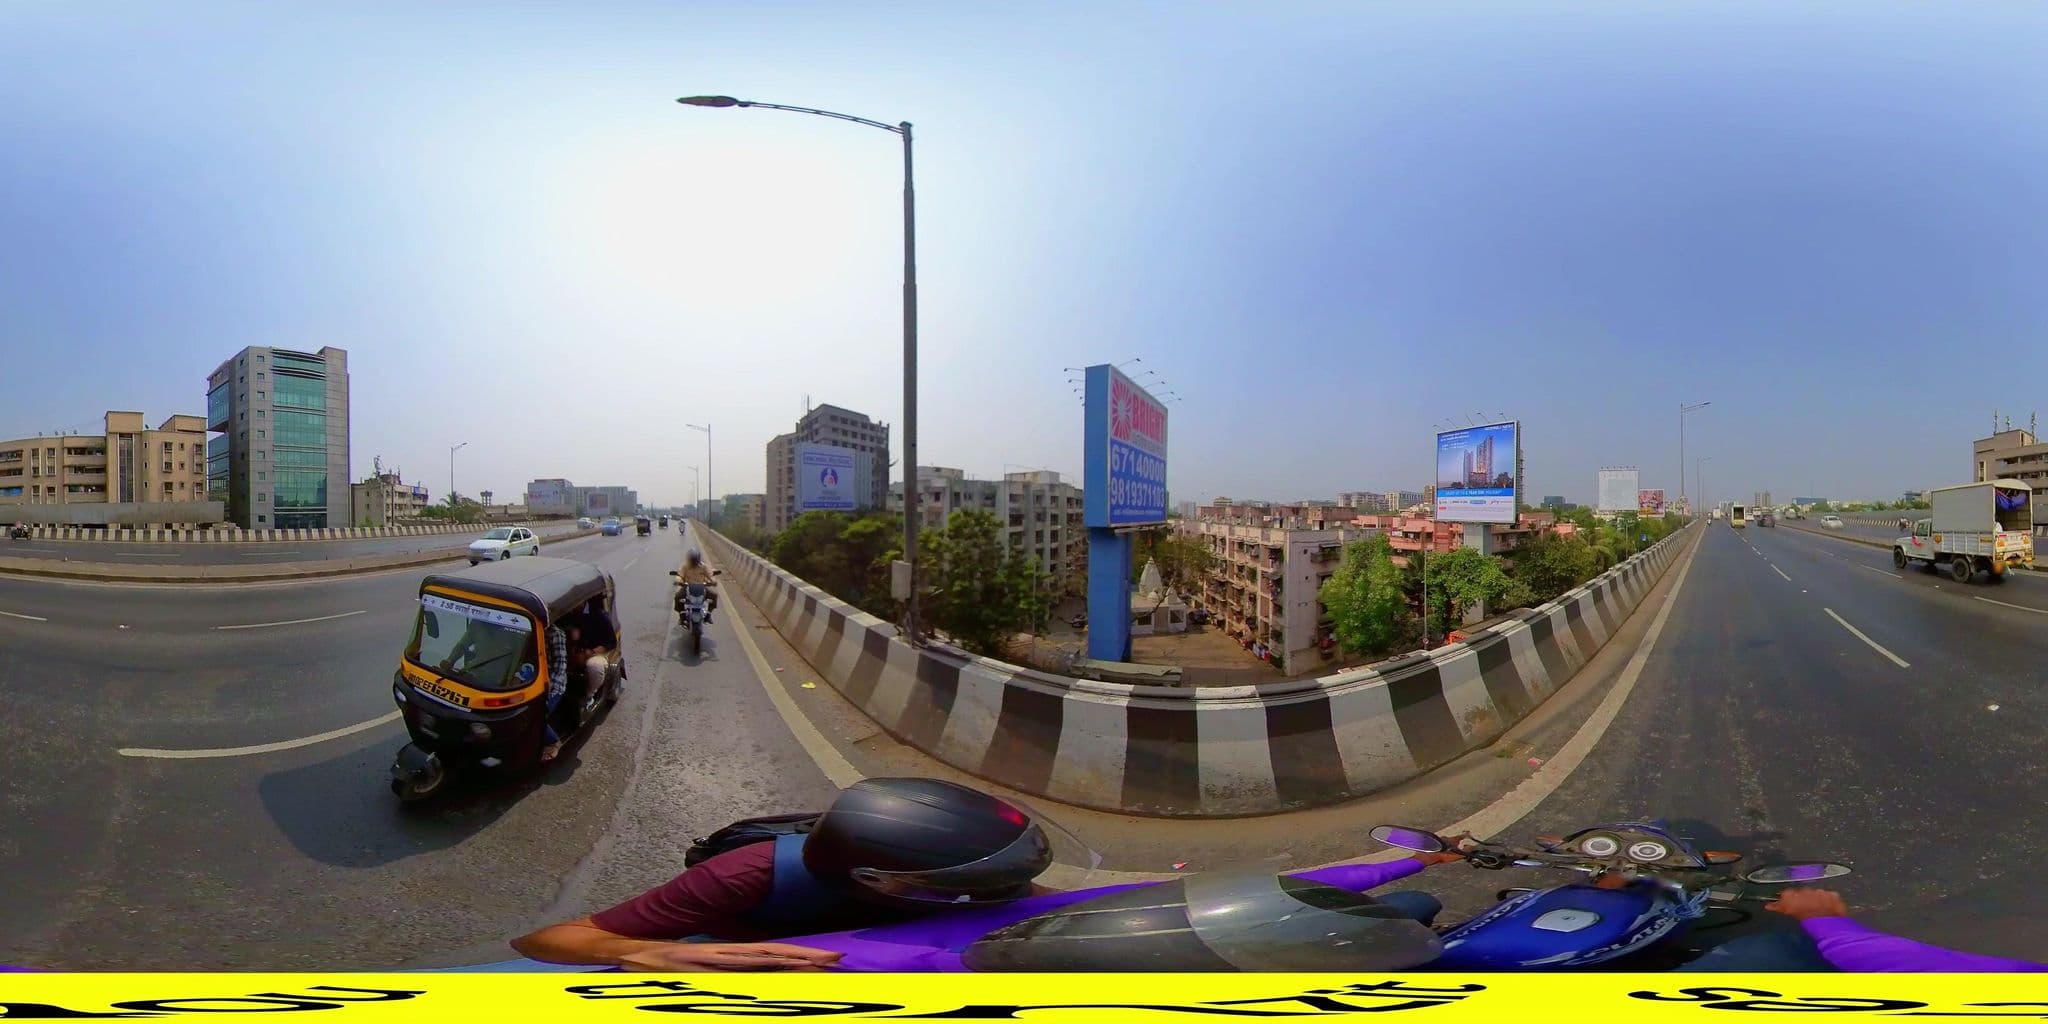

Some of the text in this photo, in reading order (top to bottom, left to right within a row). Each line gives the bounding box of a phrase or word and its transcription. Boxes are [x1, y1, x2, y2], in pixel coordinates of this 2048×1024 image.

[1132, 394, 1165, 445] BRIGHT
[1111, 444, 1165, 482] 67140000
[1111, 477, 1165, 507] 9819371103
